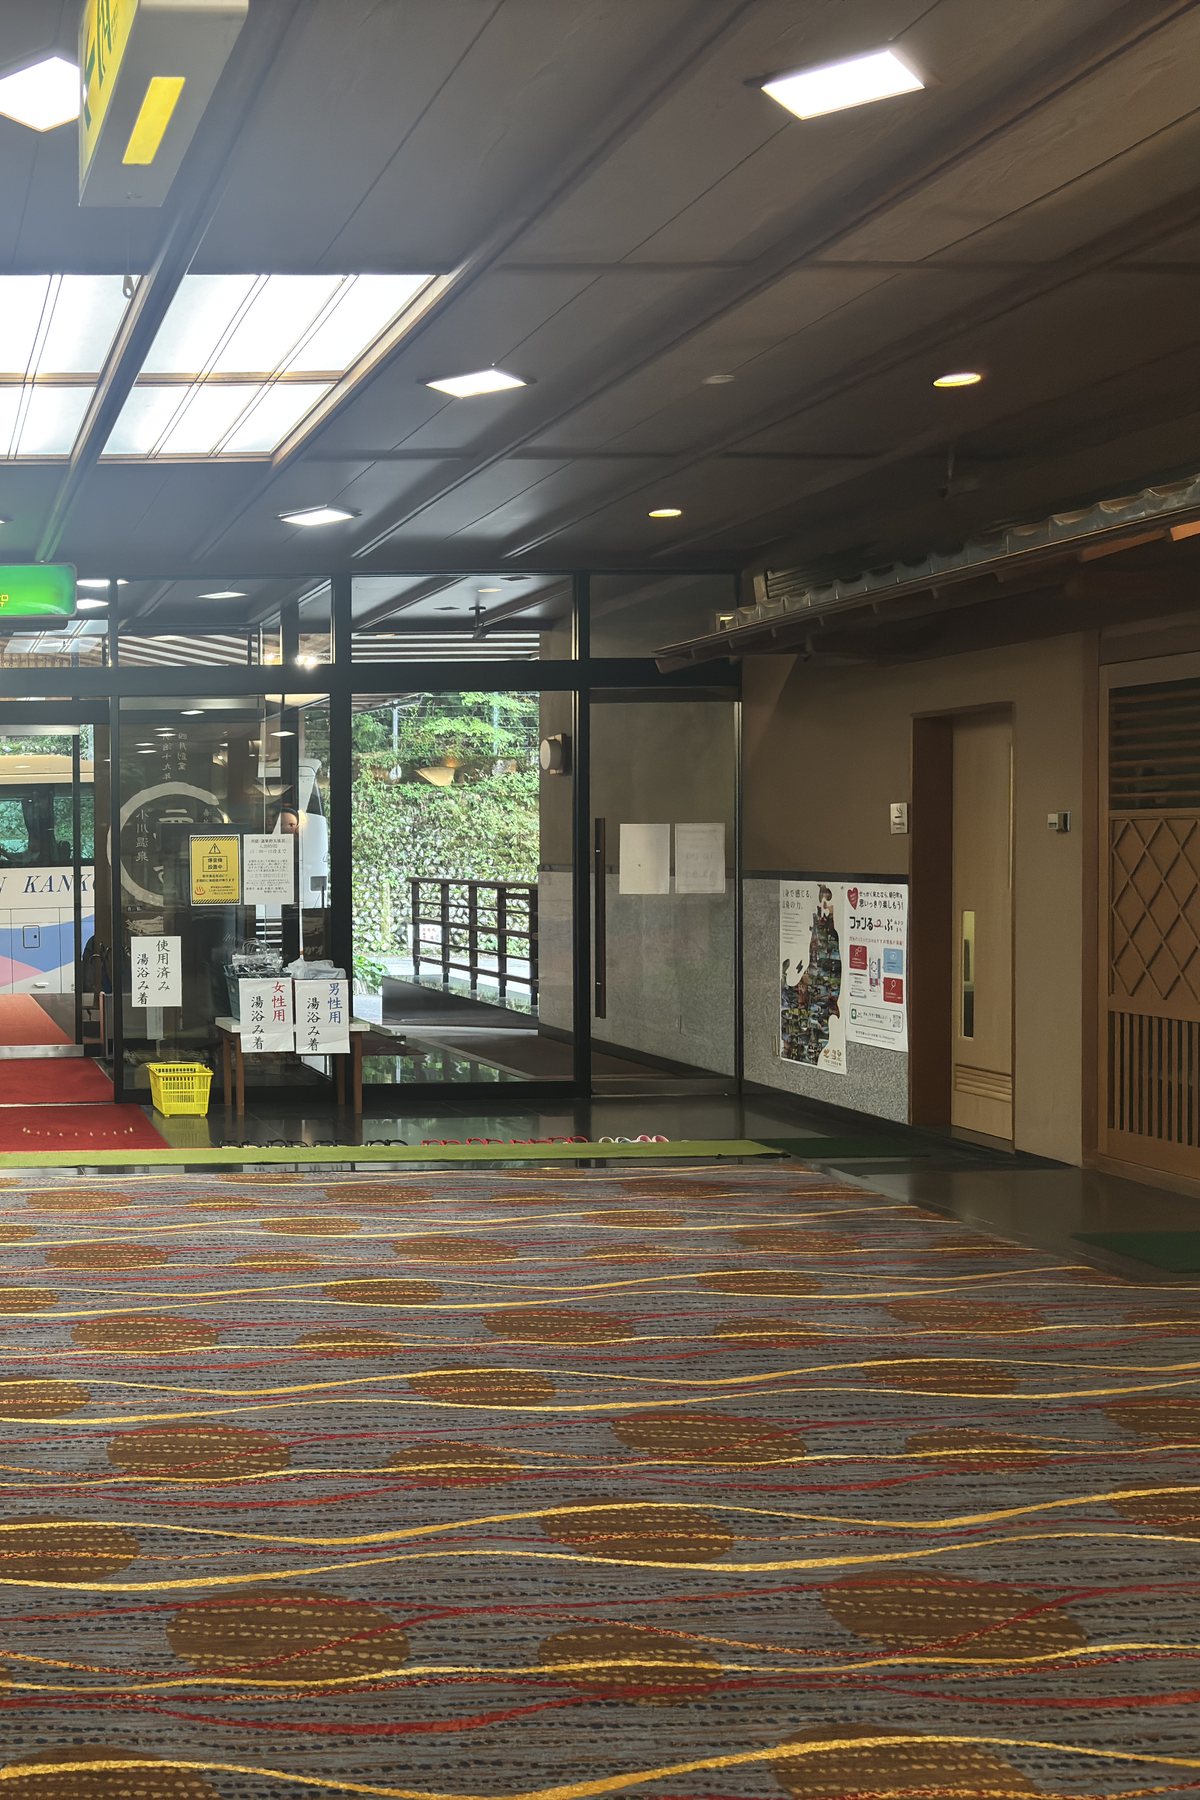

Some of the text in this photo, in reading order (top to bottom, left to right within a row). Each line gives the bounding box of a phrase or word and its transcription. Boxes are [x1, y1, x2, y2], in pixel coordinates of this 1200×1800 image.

[22, 874, 95, 894] KANK
[137, 953, 150, 1005] 湯浴み着
[156, 939, 171, 991] 使用済み
[251, 996, 265, 1050] 湯浴み着
[272, 981, 287, 1022] 女性用
[307, 997, 321, 1051] 湯浴み着
[327, 982, 343, 1024] 男性用
